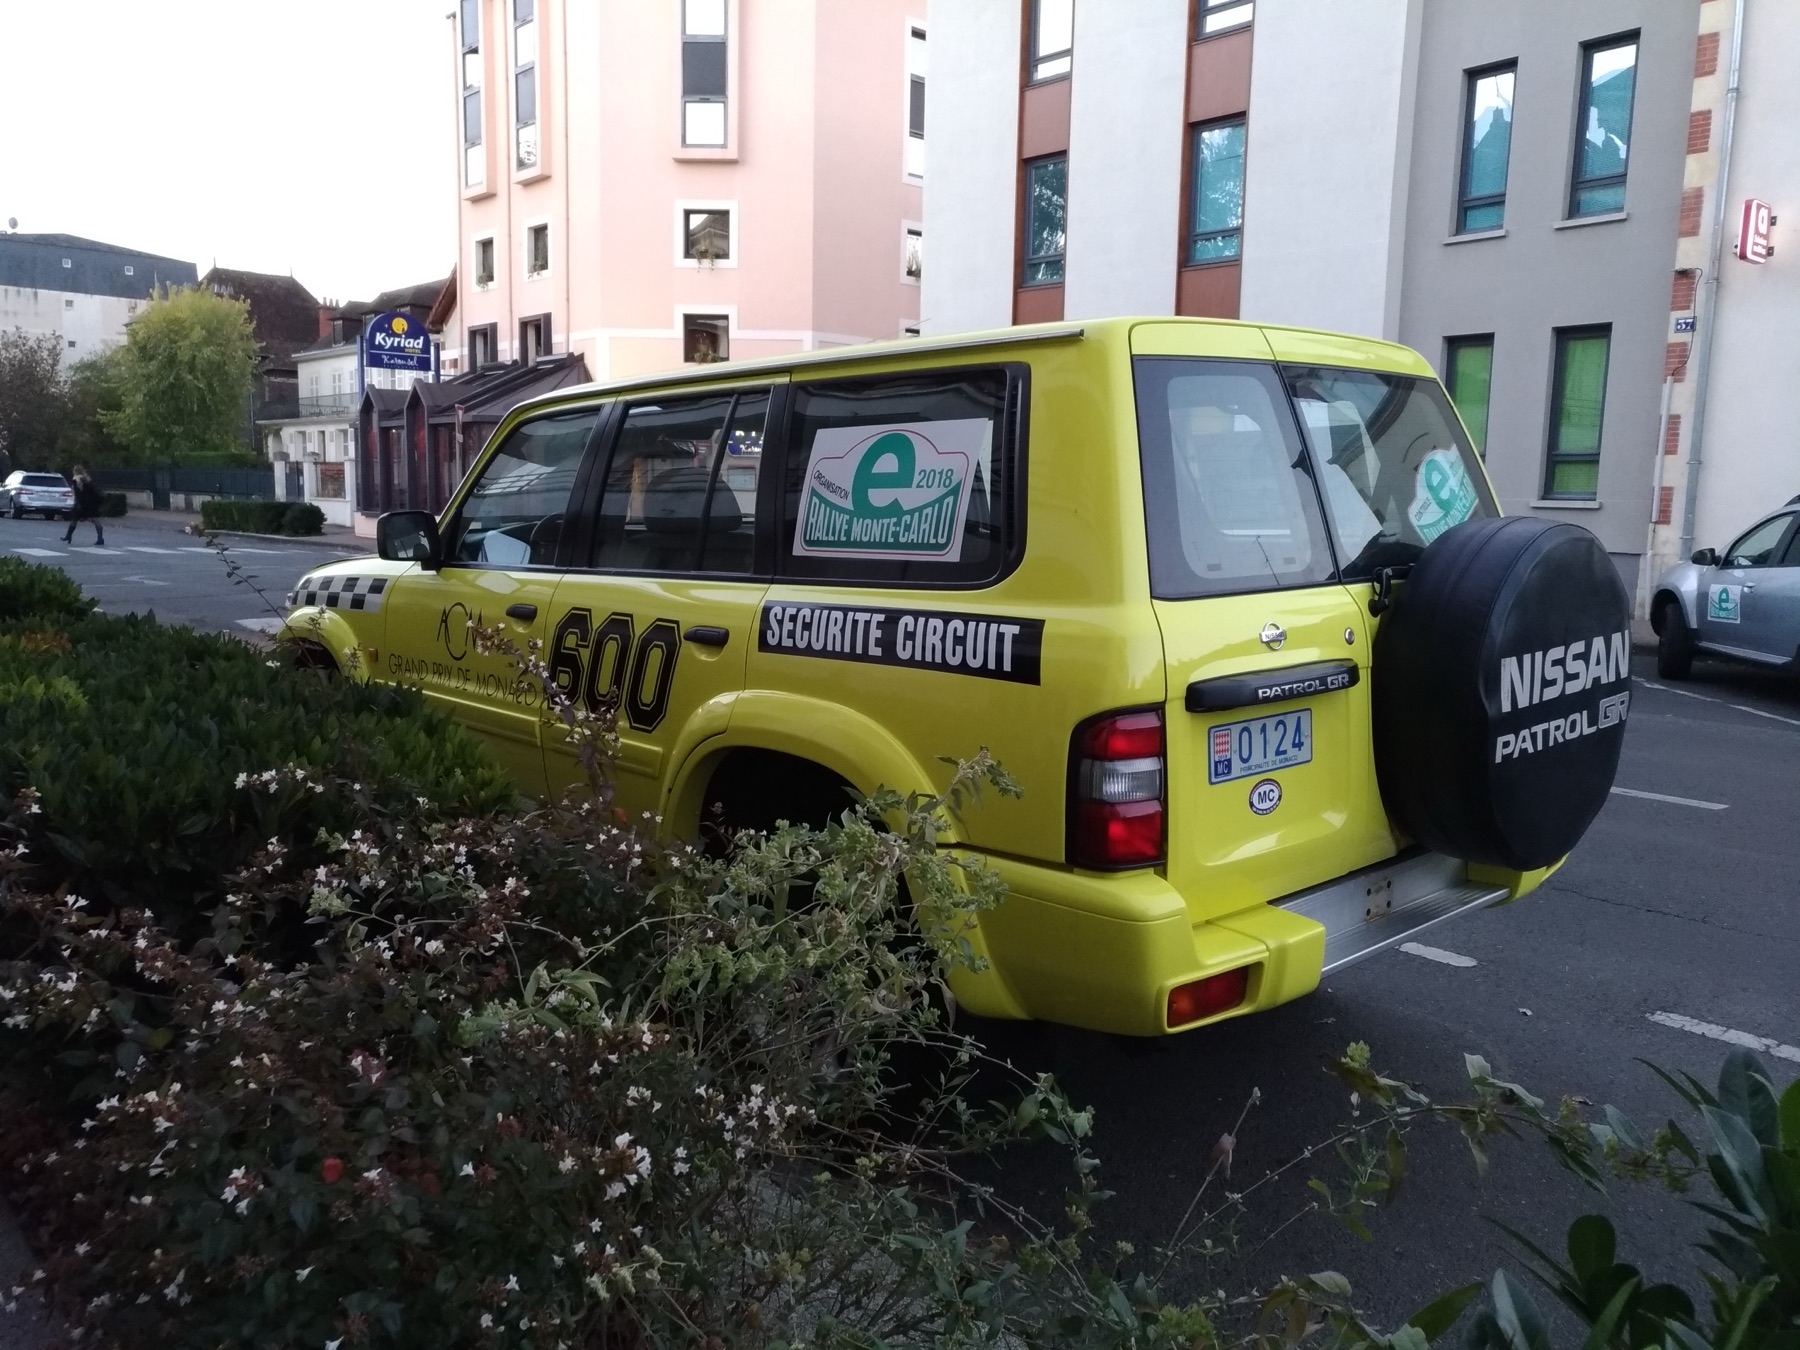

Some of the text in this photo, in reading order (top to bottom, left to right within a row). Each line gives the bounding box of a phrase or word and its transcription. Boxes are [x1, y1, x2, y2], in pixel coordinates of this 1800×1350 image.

[375, 332, 424, 349] Kyriad
[813, 469, 850, 501] ORGANISATION
[916, 469, 954, 489] 2018
[806, 495, 954, 544] RALLYE MONTE-CARLO
[766, 605, 1020, 672] SECURITE CIRCUIT
[388, 653, 537, 706] GRAND PRIX DE MONACO
[547, 607, 682, 734] 600
[1258, 673, 1349, 700] PATROL GR
[1501, 629, 1629, 713] NISSAN
[1238, 716, 1304, 765] 0124
[1495, 691, 1630, 764] PATROL GR
[1217, 761, 1229, 775] MC
[1271, 758, 1278, 767] DE
[1278, 755, 1298, 766] MONACO
[1258, 788, 1275, 805] MC
